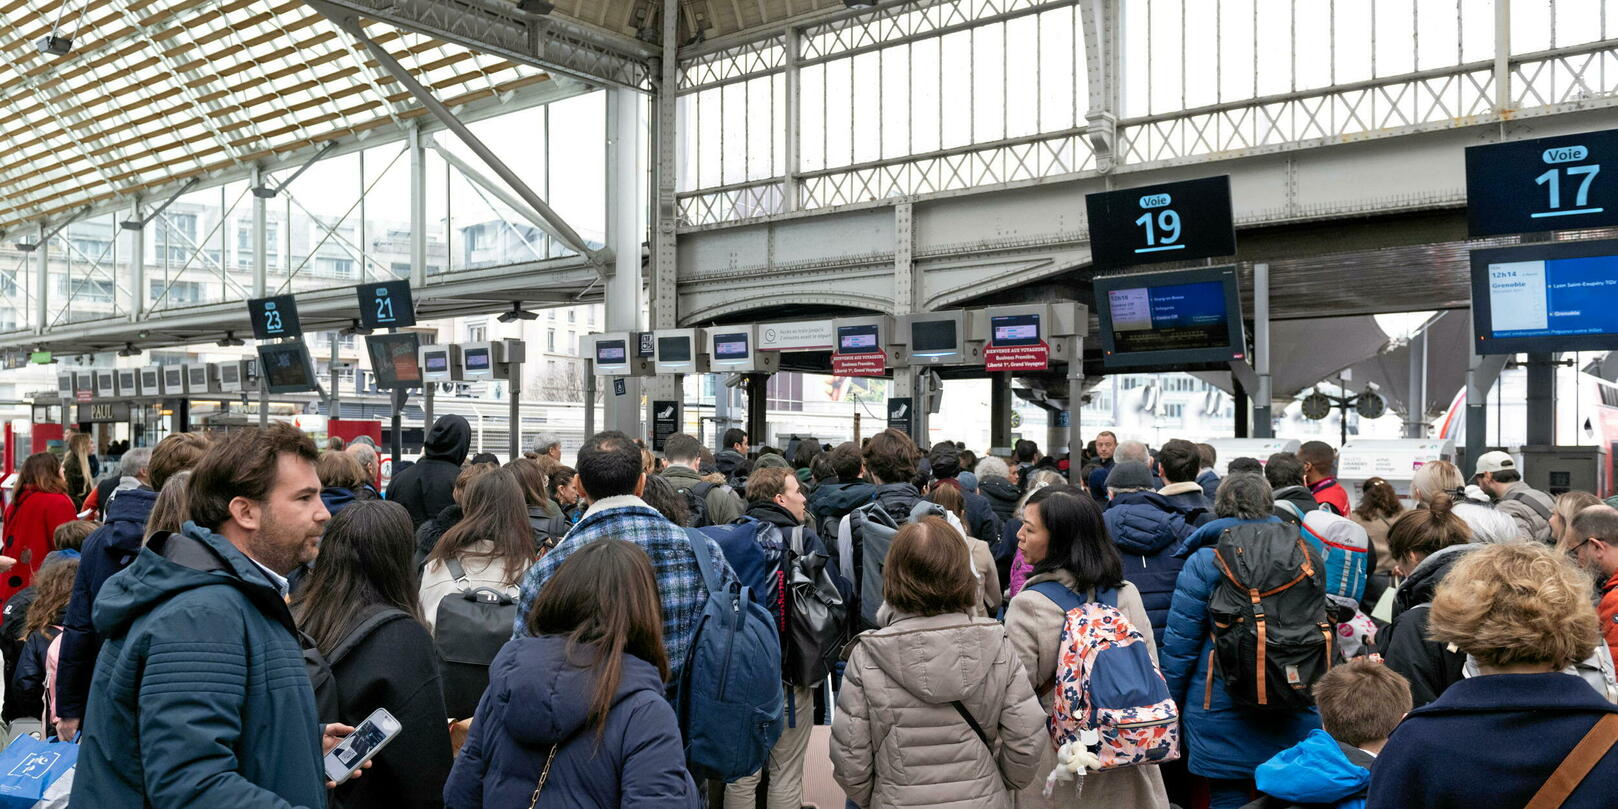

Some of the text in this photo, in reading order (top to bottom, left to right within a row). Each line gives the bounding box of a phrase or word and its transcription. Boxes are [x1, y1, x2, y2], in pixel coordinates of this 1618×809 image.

[1548, 149, 1582, 161] Voie
[1535, 164, 1601, 209] 17
[1143, 197, 1167, 207] Voie
[1135, 209, 1182, 246] 19
[1492, 281, 1526, 289] Grenoble
[375, 297, 393, 318] 21
[264, 311, 282, 330] 23
[91, 405, 113, 419] PAUL
